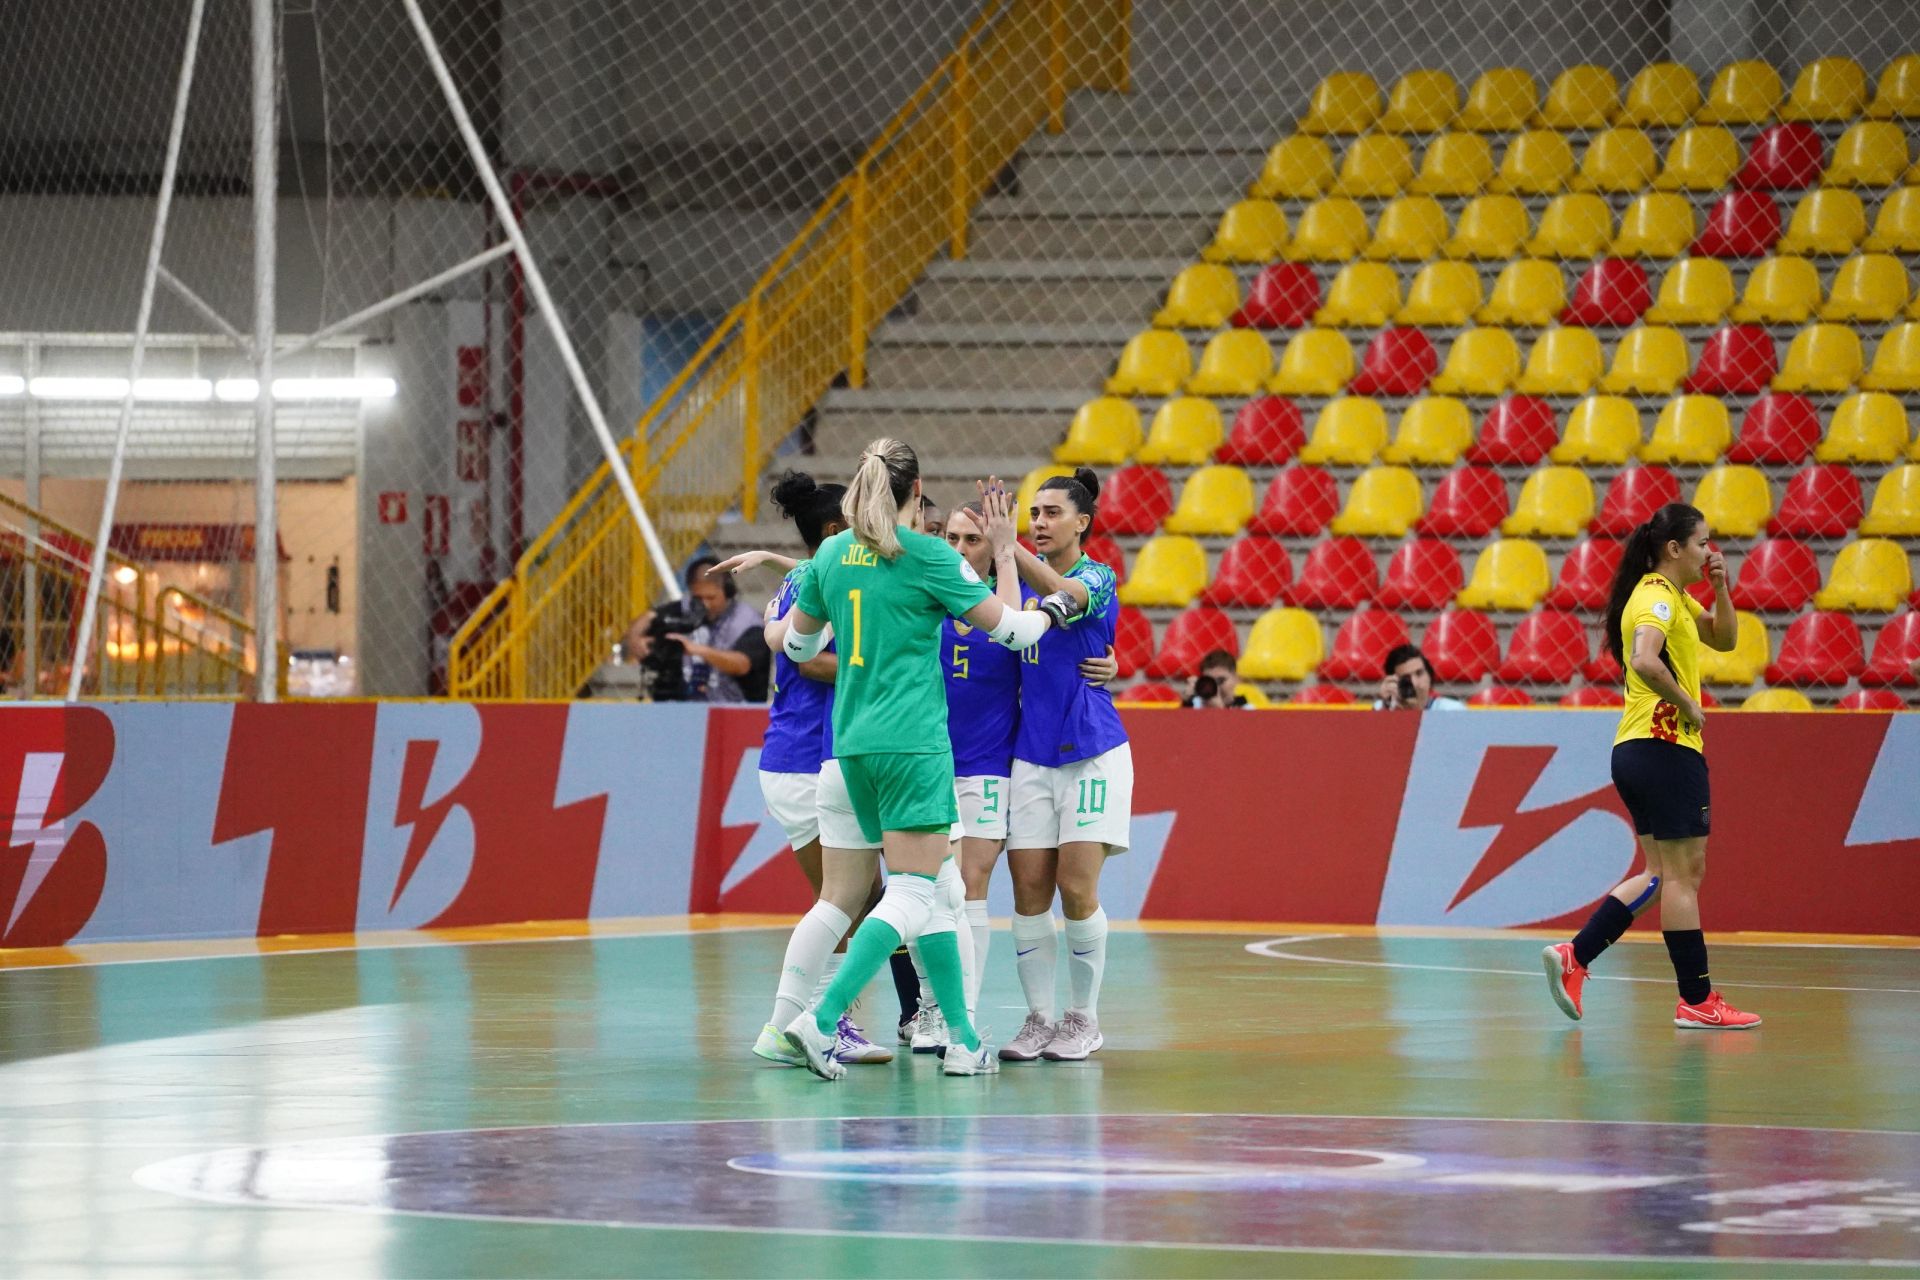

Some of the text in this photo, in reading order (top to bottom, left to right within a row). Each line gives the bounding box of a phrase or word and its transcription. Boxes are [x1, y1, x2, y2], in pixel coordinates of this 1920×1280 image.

[848, 588, 865, 667] 1
[952, 644, 969, 679] 5
[983, 778, 999, 813] 5
[1076, 778, 1107, 814] 10
